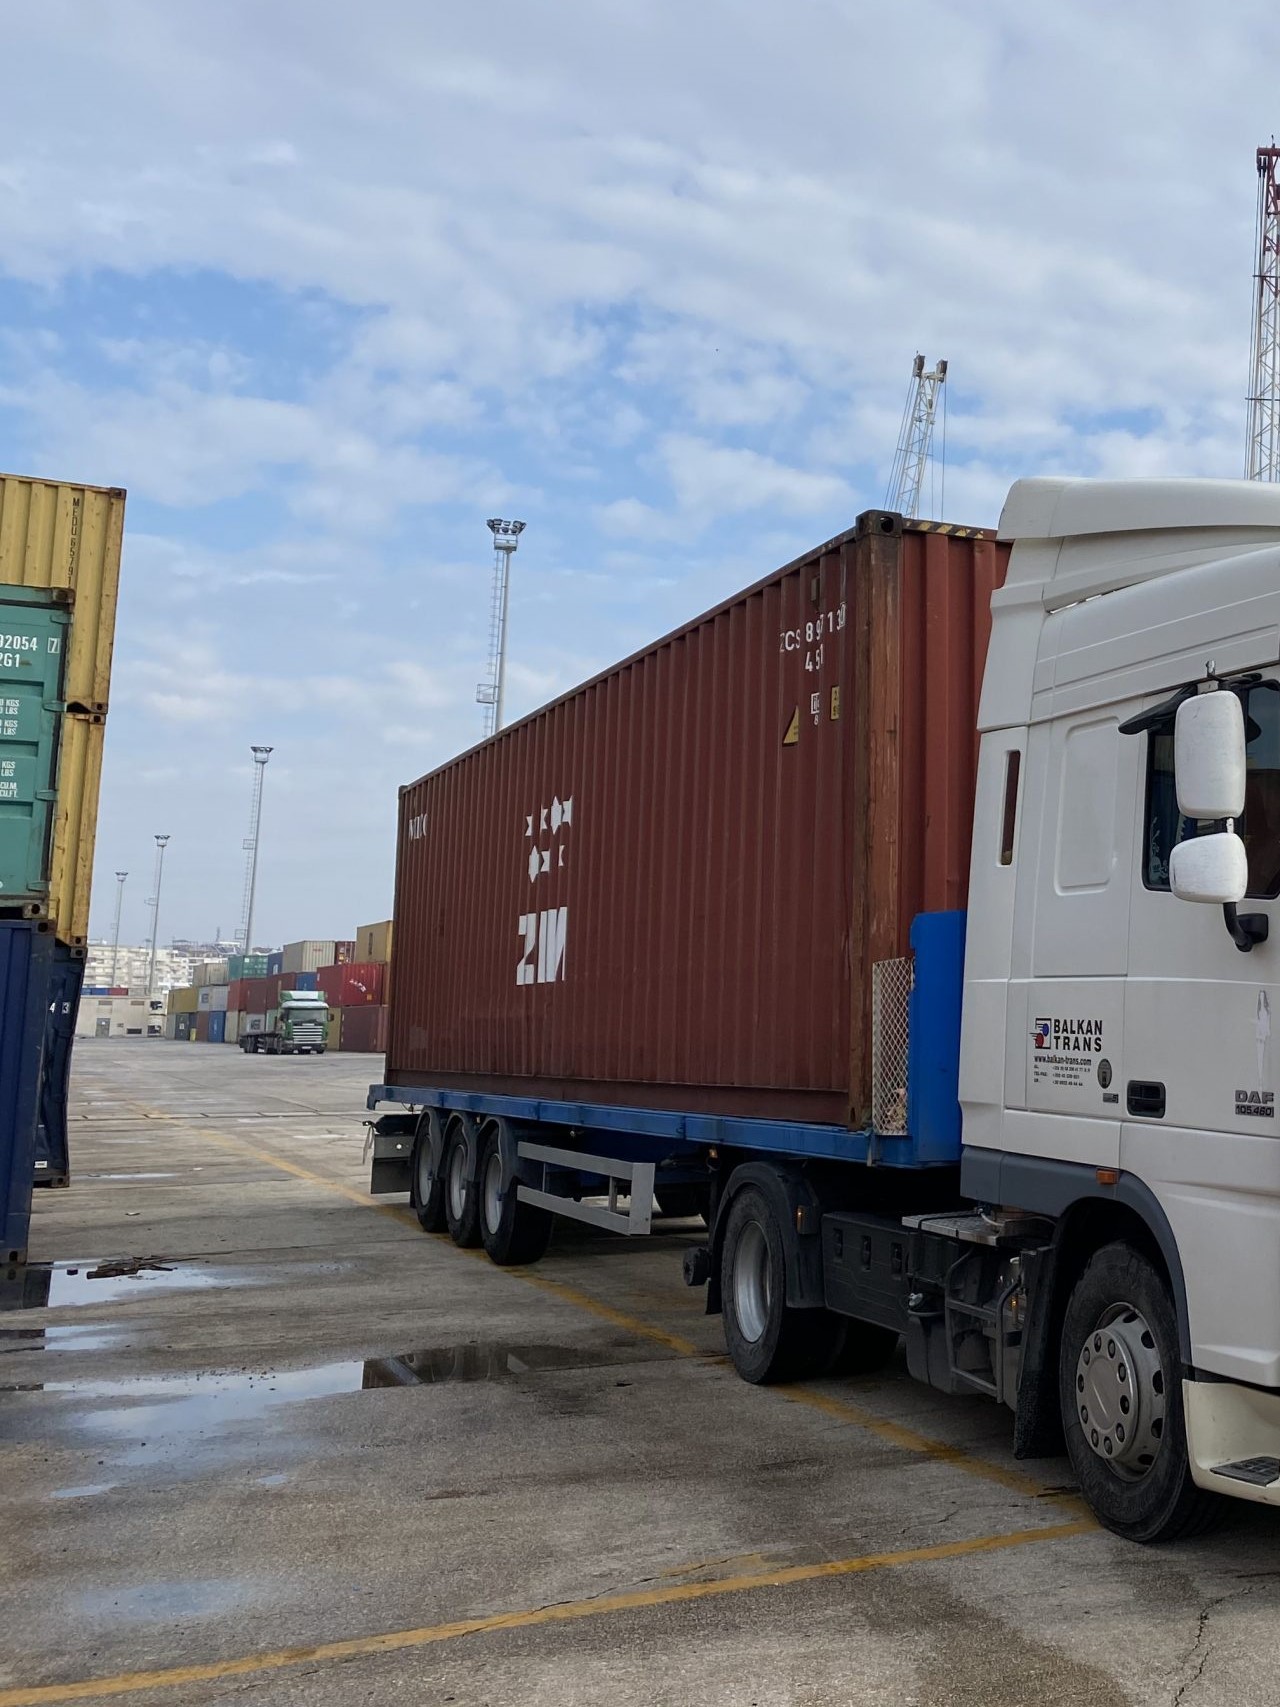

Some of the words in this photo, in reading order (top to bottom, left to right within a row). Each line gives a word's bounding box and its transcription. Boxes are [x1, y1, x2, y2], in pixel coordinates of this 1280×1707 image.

[48, 638, 59, 653] 7
[516, 906, 568, 986] ZIM
[1054, 1019, 1103, 1036] BALKAN
[1054, 1036, 1102, 1052] TRANS
[1034, 1055, 1092, 1066] www.balkan-trans.com
[1235, 1090, 1275, 1104] DAF
